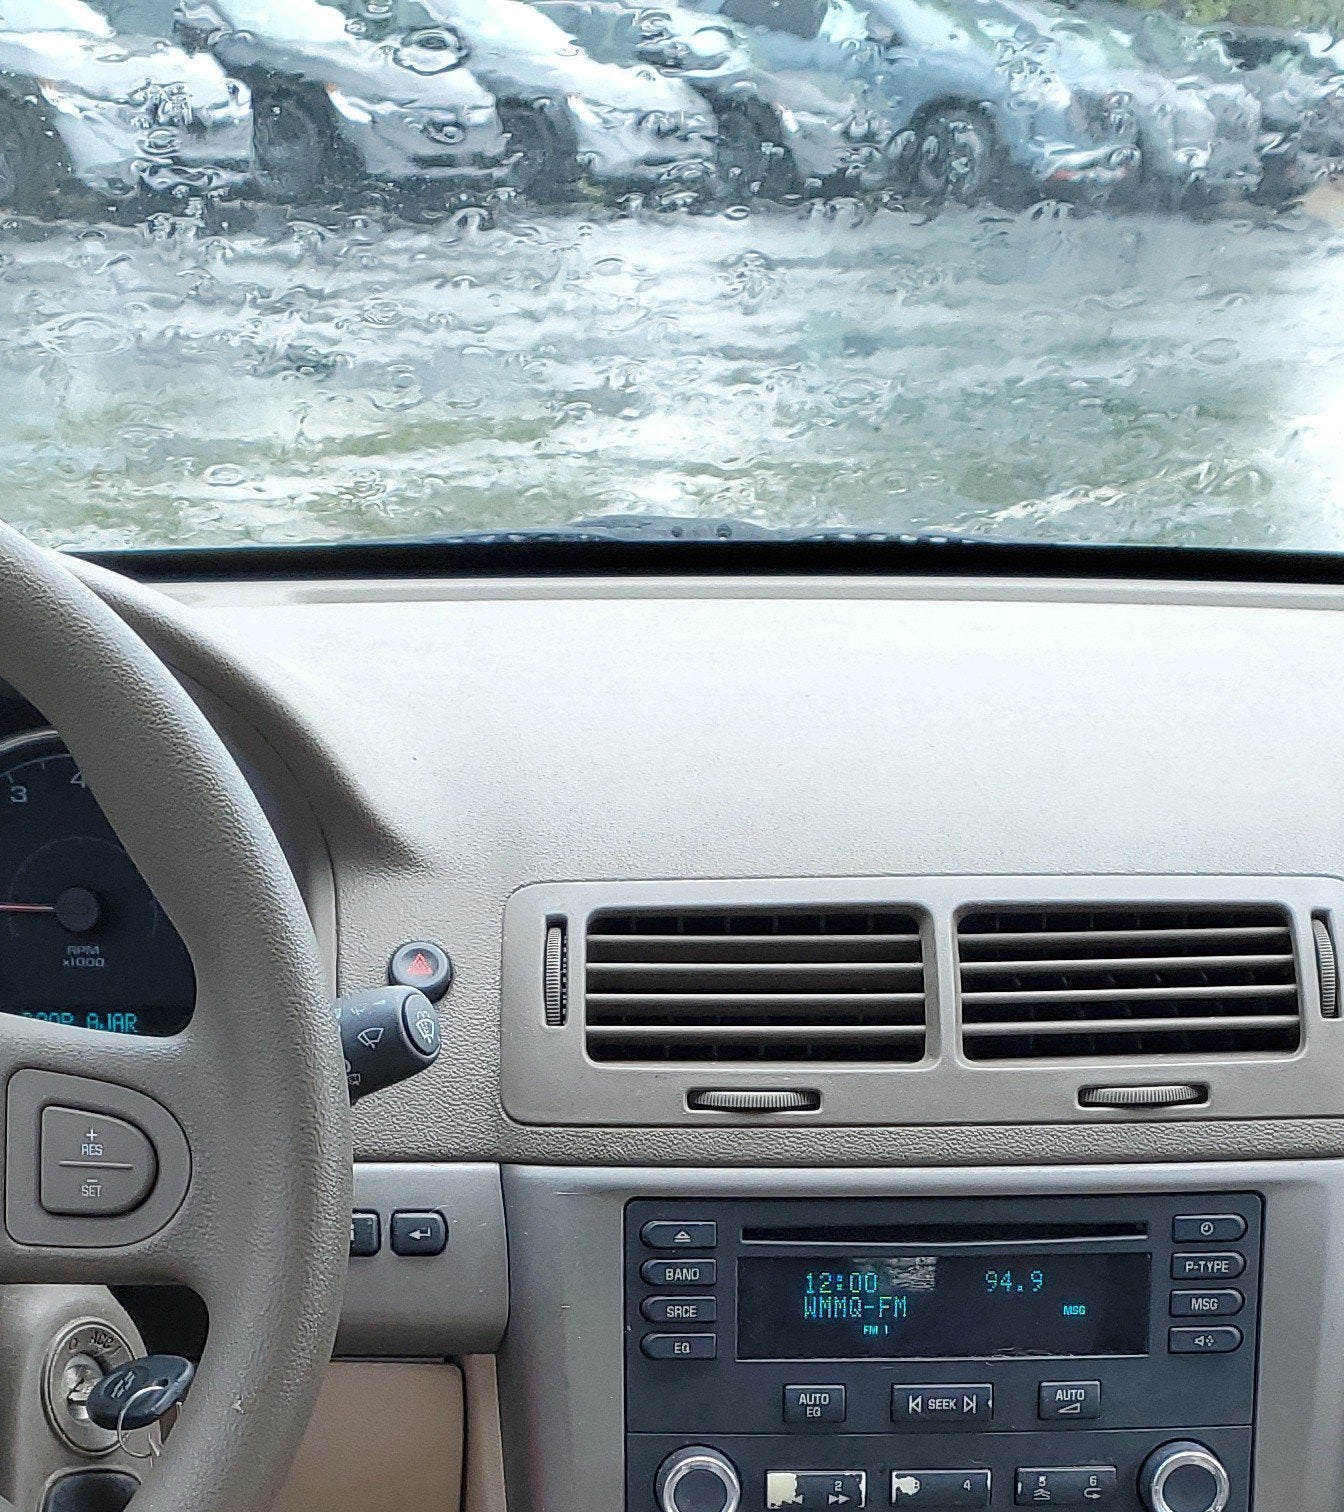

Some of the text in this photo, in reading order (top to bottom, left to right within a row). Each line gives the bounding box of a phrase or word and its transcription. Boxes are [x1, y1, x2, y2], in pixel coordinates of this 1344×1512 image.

[70, 772, 86, 788] 4
[11, 786, 28, 803] 3
[67, 945, 100, 956] RPM
[81, 1143, 104, 1157] RES
[80, 1185, 103, 1198] SET
[1185, 1260, 1229, 1274] P-TYPE
[665, 1267, 700, 1281] BAND
[805, 1271, 879, 1295] 12:00
[984, 1269, 1044, 1293] 94.9
[803, 1296, 908, 1319] WMMQ-FM
[1062, 1304, 1086, 1316] MSG
[1190, 1297, 1218, 1311] MSG
[666, 1305, 697, 1319] SRCE
[863, 1325, 879, 1335] FM
[674, 1342, 691, 1354] EQ
[798, 1393, 830, 1405] AUTO
[1055, 1389, 1085, 1401] AUTO
[927, 1399, 956, 1410] SEEK
[806, 1406, 822, 1418] EQ
[834, 1480, 843, 1492] 2
[962, 1479, 971, 1491] 4
[1089, 1476, 1098, 1487] 6
